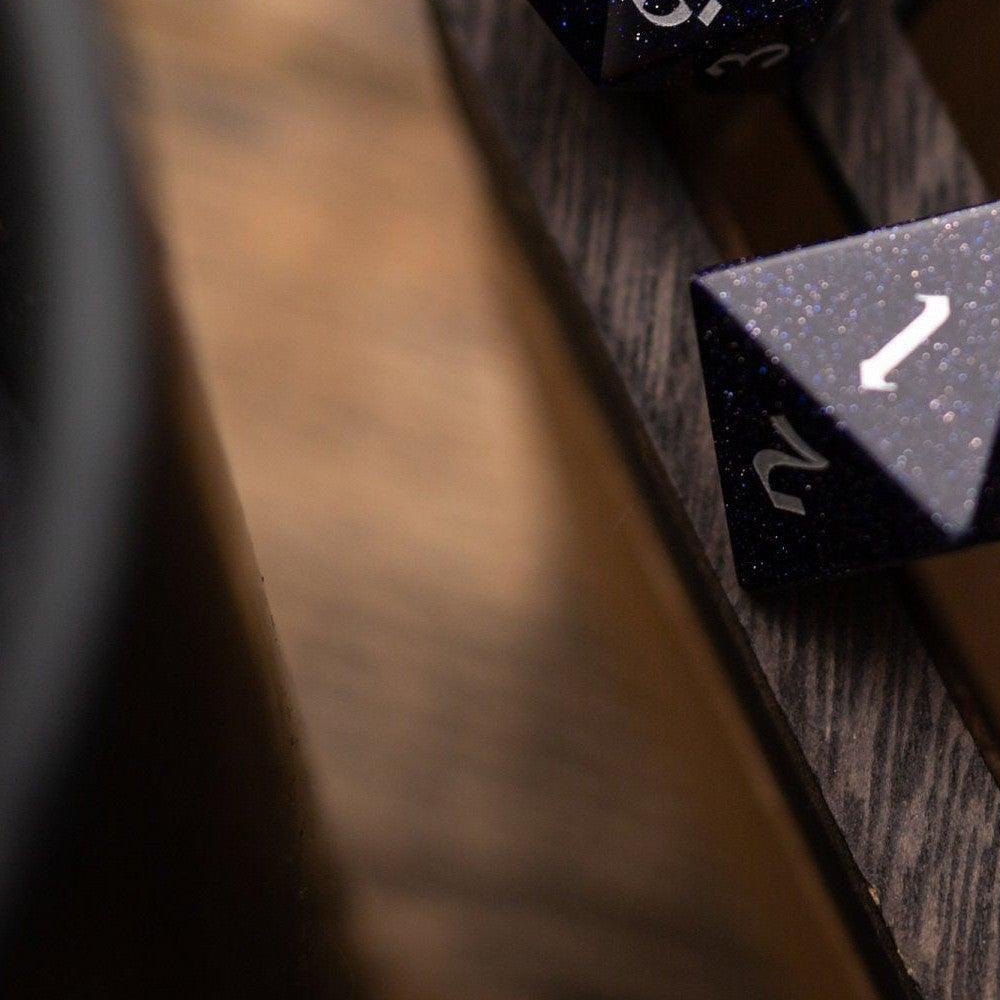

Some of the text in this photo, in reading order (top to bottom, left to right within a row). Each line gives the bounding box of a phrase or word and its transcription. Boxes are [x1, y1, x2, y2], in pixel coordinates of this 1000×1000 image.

[705, 44, 790, 76] 3
[859, 294, 950, 391] 1
[752, 414, 829, 515] 2
